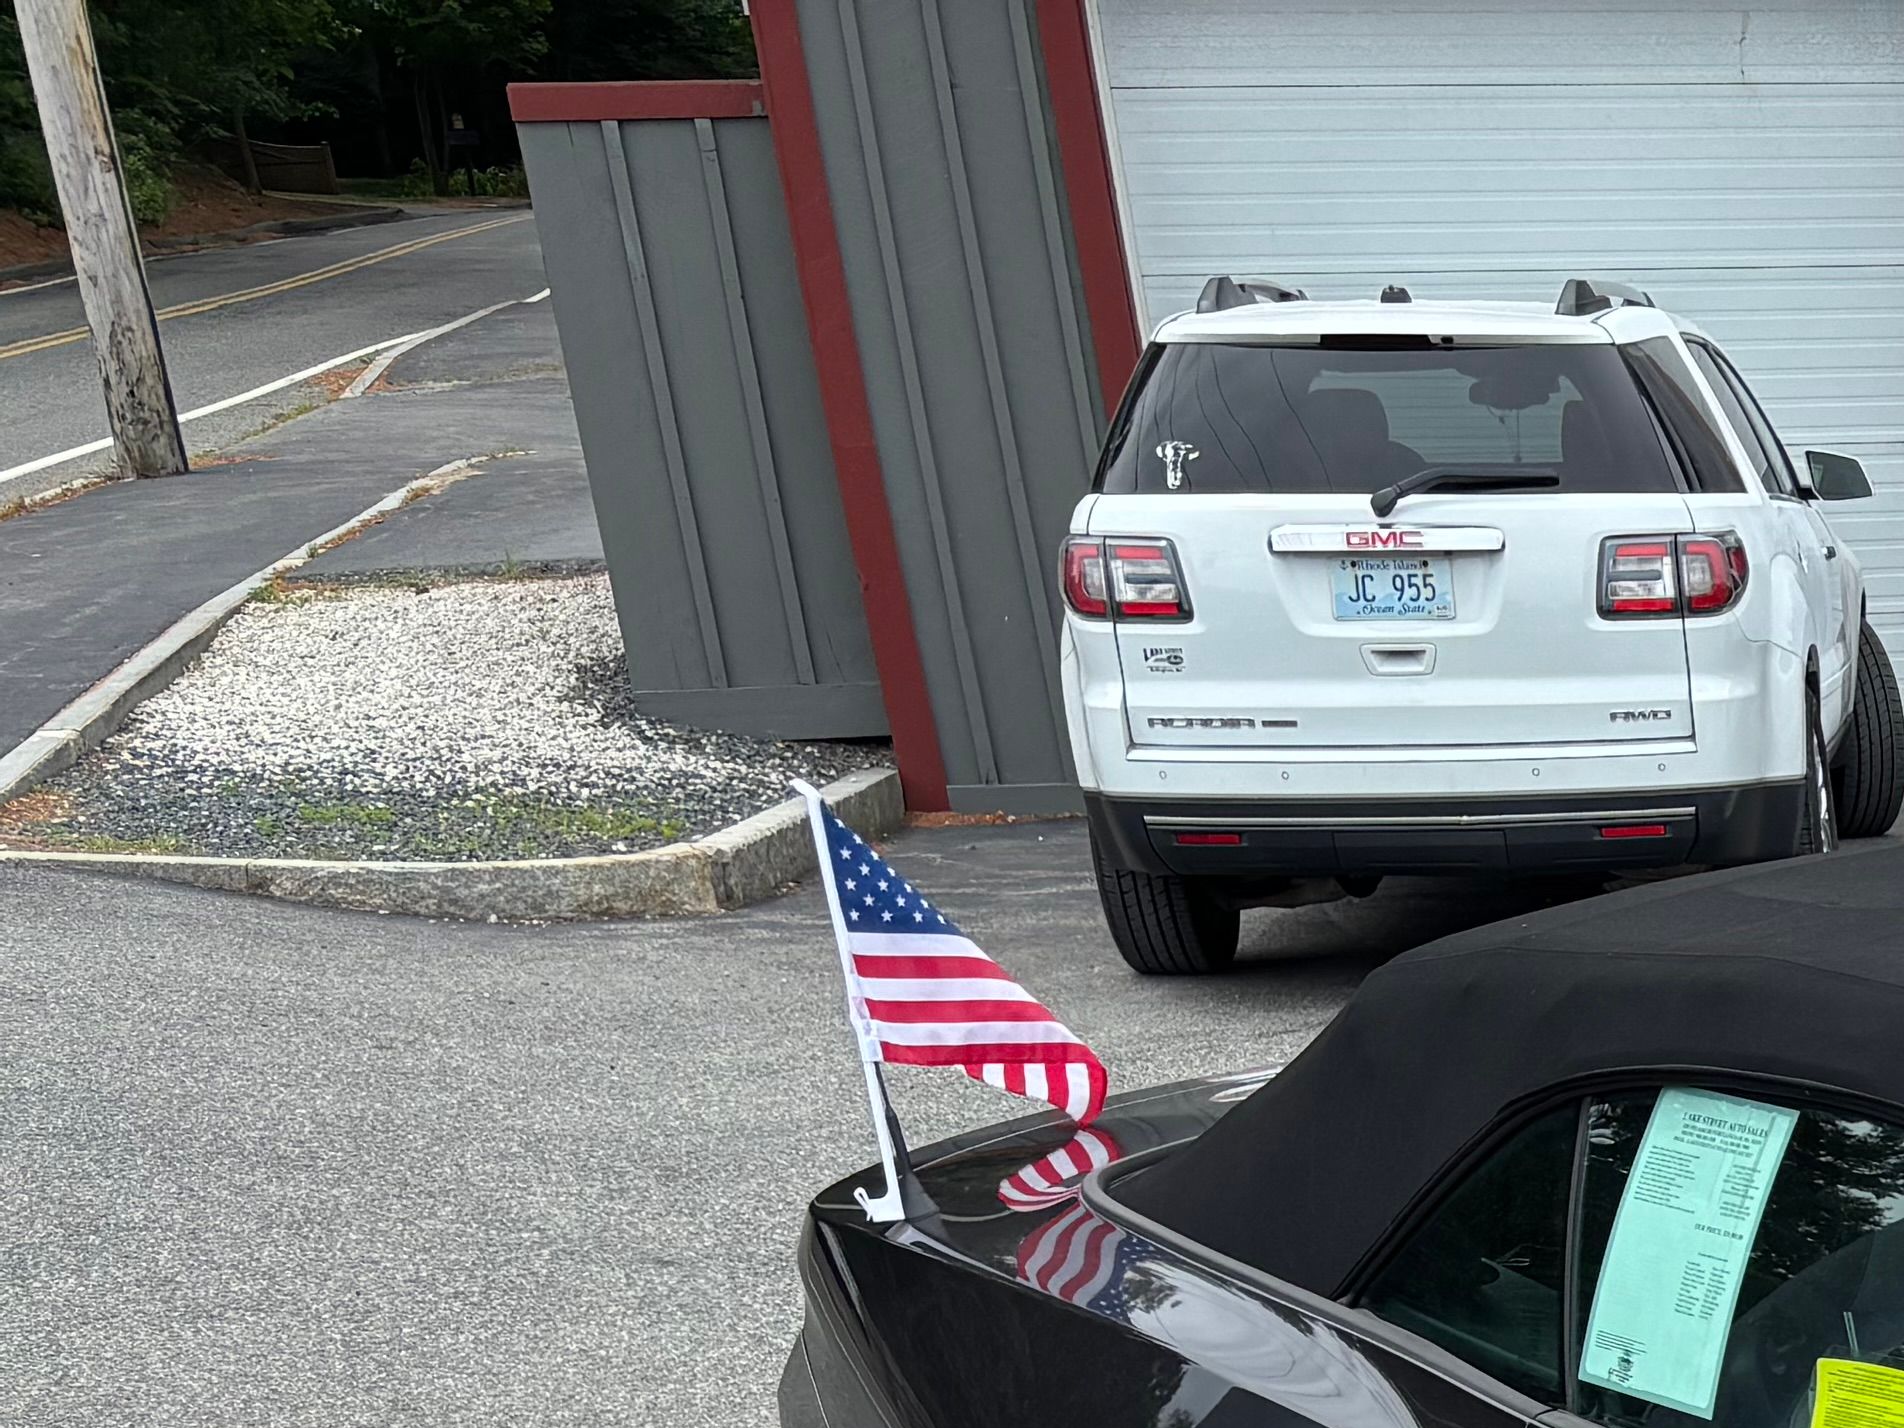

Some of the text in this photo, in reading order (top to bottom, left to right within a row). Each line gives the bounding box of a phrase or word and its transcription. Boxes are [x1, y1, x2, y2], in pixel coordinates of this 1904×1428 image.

[1345, 531, 1424, 549] GMC
[1348, 573, 1437, 603] JC 955
[1362, 603, 1395, 614] Ocean
[1398, 603, 1426, 615] State
